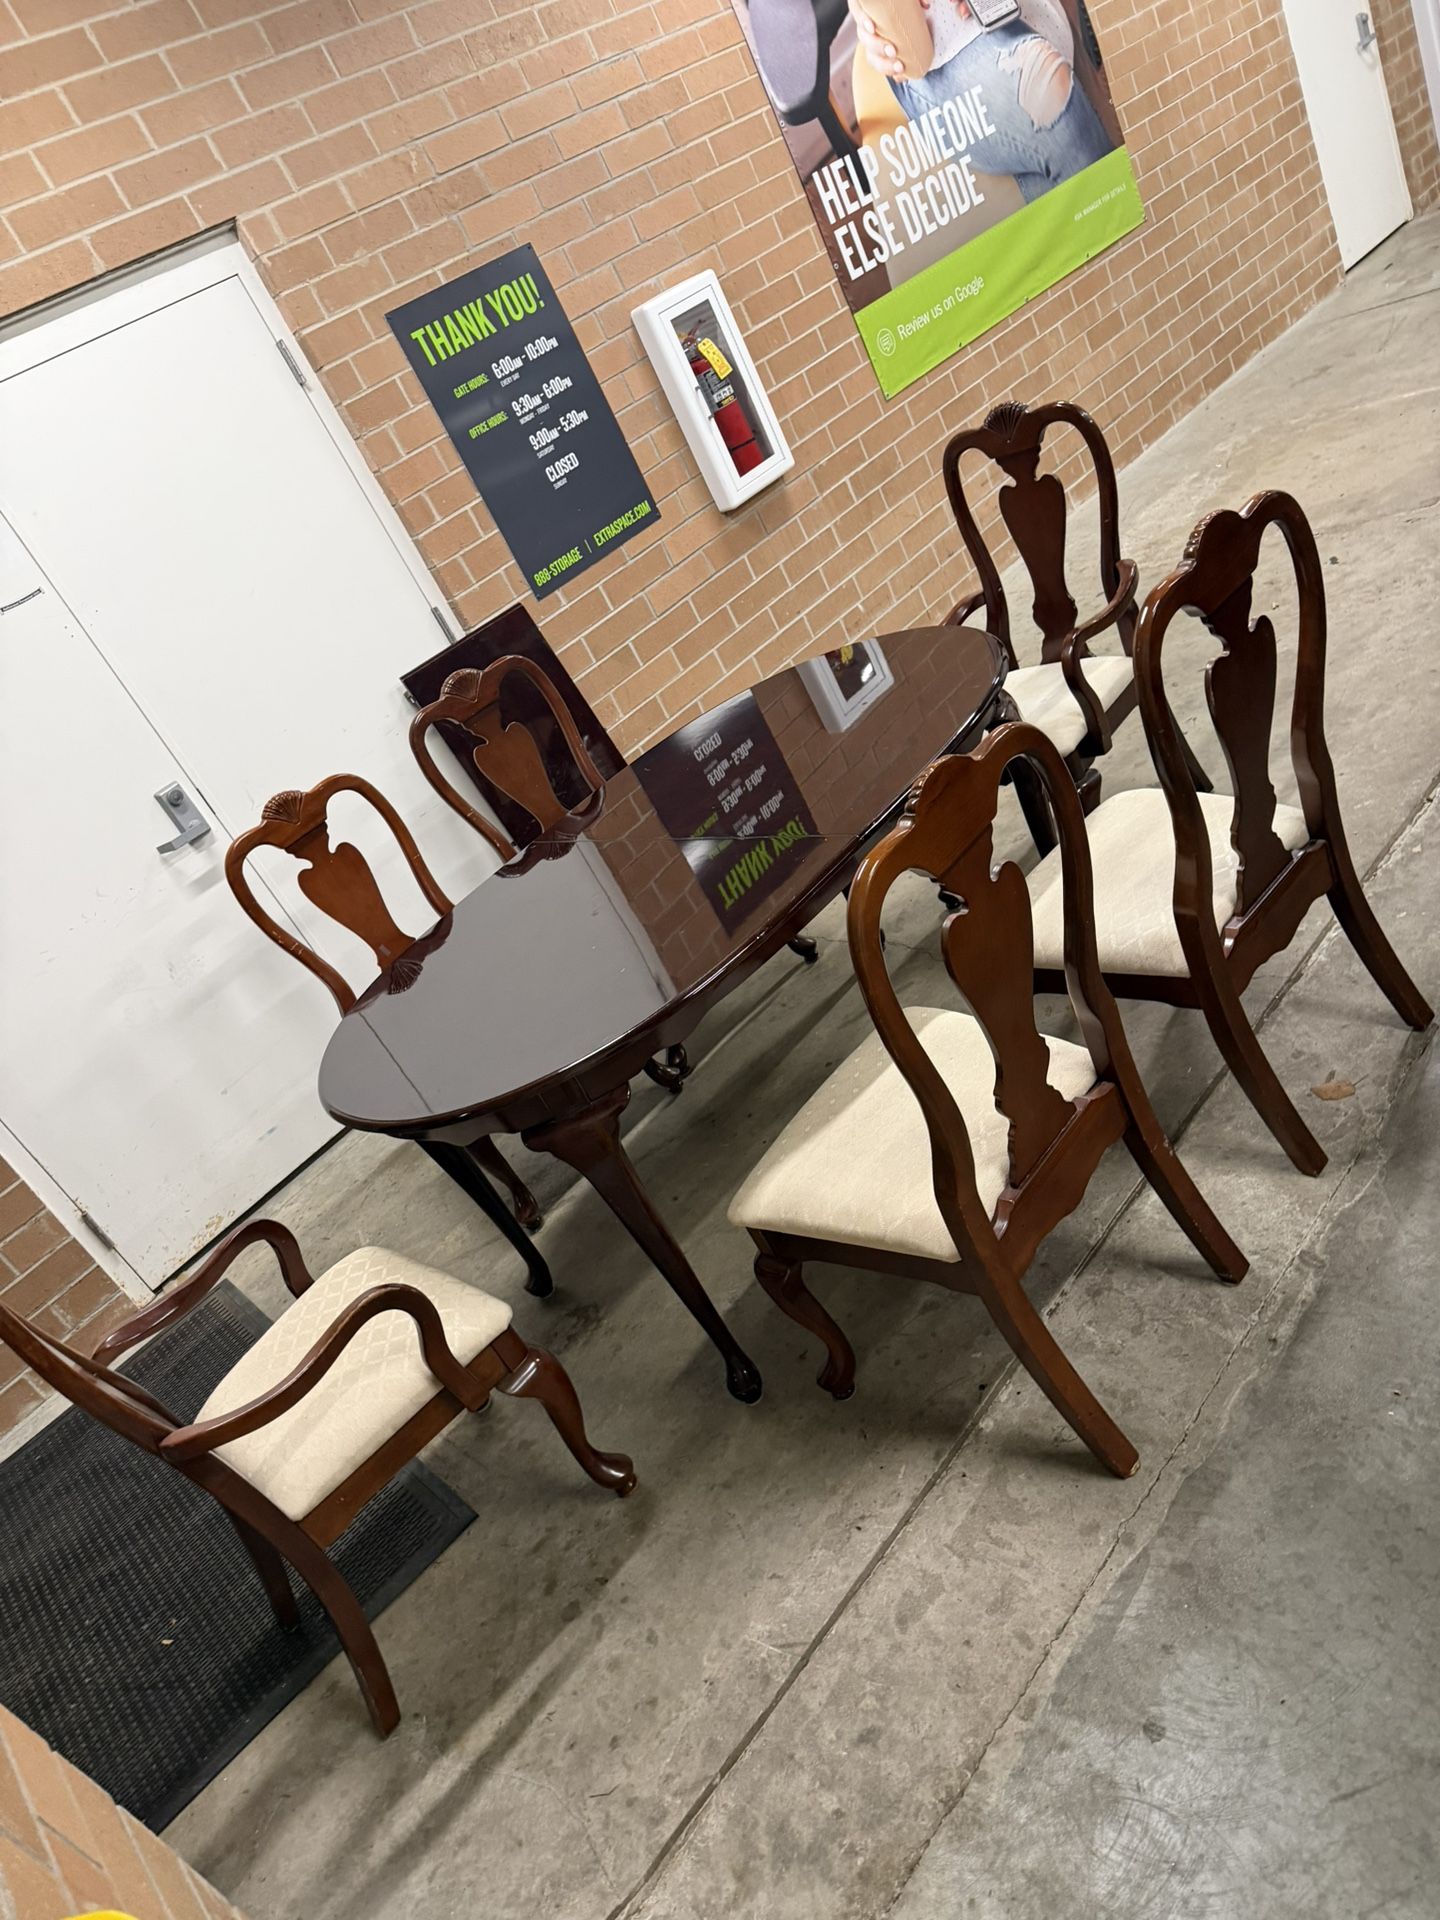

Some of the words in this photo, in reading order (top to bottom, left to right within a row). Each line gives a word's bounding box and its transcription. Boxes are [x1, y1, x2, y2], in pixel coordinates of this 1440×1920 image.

[812, 144, 881, 225] HELP
[879, 84, 996, 188] SOMEONE
[833, 201, 905, 281] ELSE
[895, 154, 985, 245] DECIDE
[410, 297, 498, 367] THANK
[484, 272, 545, 328] YOU!
[897, 312, 930, 340] Review
[931, 303, 943, 319] us
[943, 295, 956, 311] on
[954, 276, 985, 302] Google
[491, 355, 524, 379] 6:00AM
[524, 336, 559, 361] 10:00PM
[453, 385, 471, 399] GATE
[467, 373, 490, 391] HOURS:
[511, 393, 543, 417] 9:30AM
[542, 376, 573, 399] 6:00PM
[468, 420, 490, 440] OFFICE
[486, 410, 509, 428] HOURS:
[528, 427, 560, 450] 9:00AM
[559, 409, 589, 432] 5:30PM
[545, 452, 580, 482] CLOSED
[533, 546, 583, 587] 888-STORAGE
[593, 500, 652, 547] EXTRASPACE.COM
